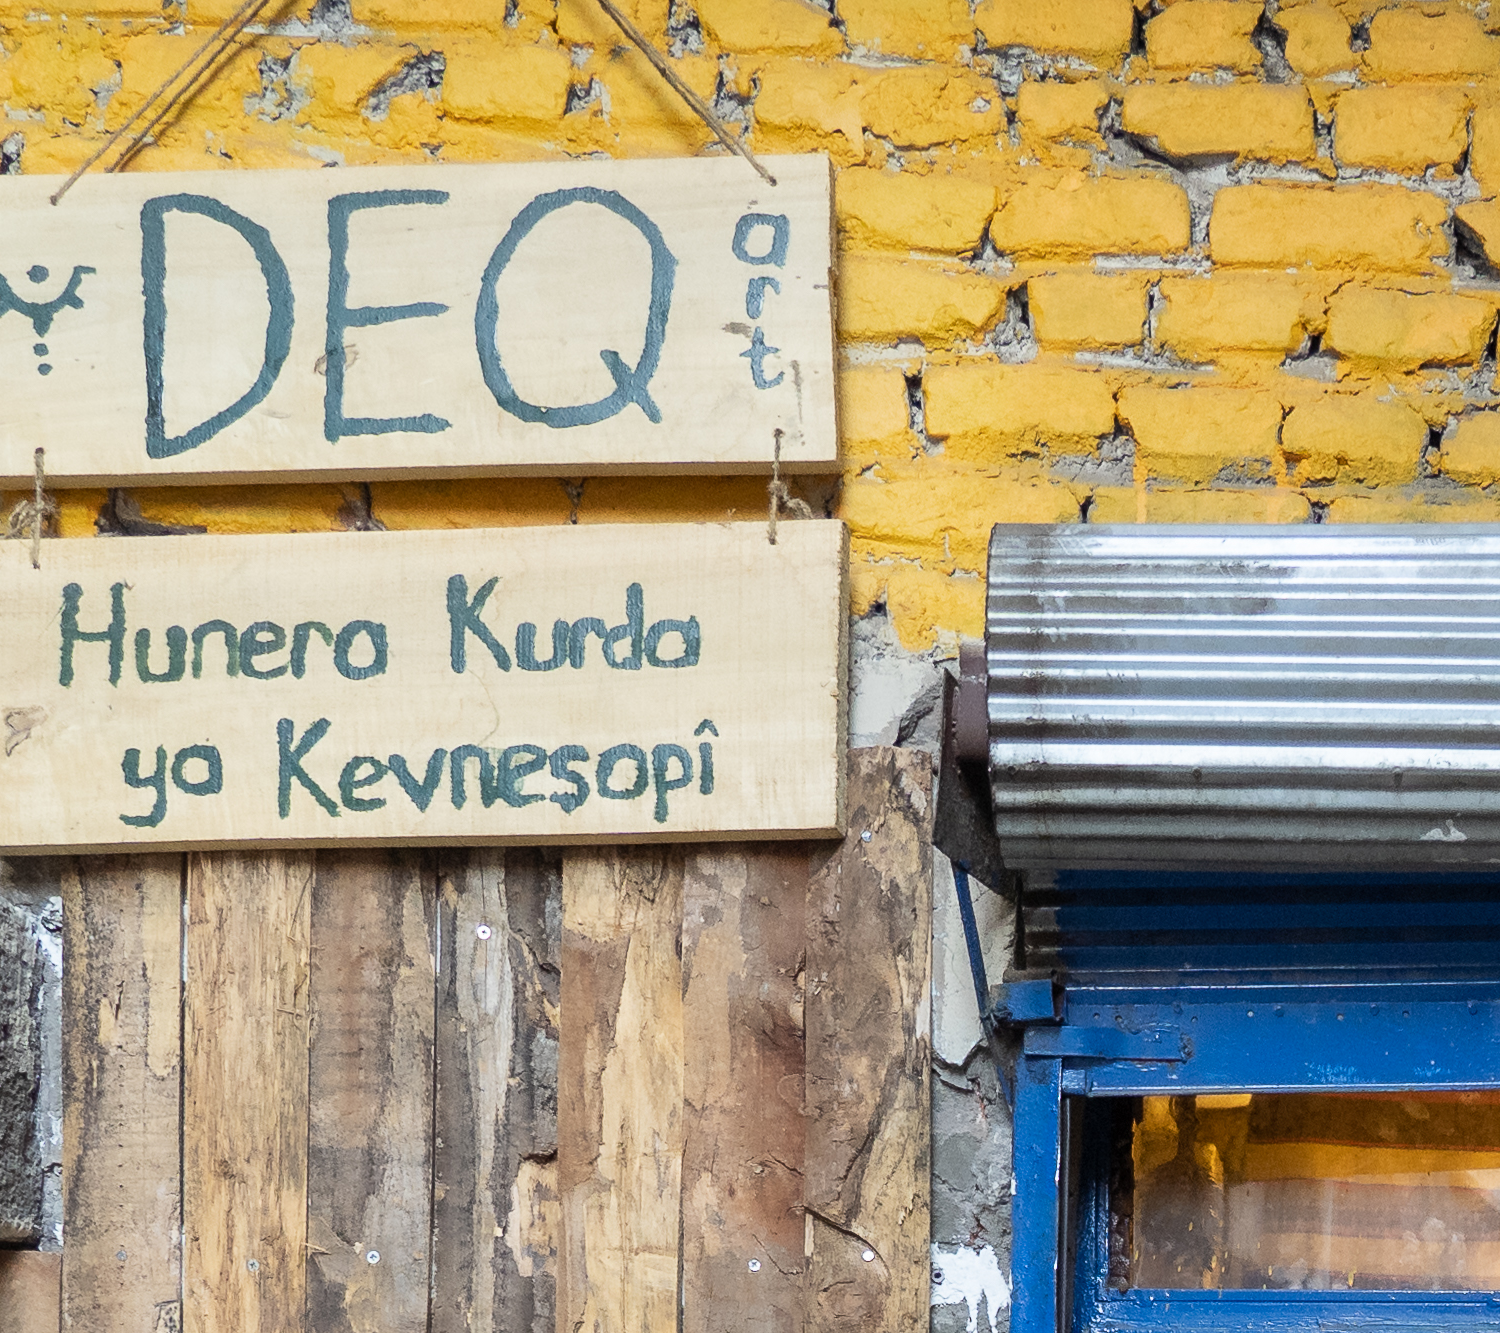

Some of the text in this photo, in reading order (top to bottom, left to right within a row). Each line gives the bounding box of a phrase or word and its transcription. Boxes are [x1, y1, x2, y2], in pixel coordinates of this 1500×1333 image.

[139, 187, 678, 460] DEQ
[731, 212, 791, 390] art
[445, 573, 701, 674] Kurda
